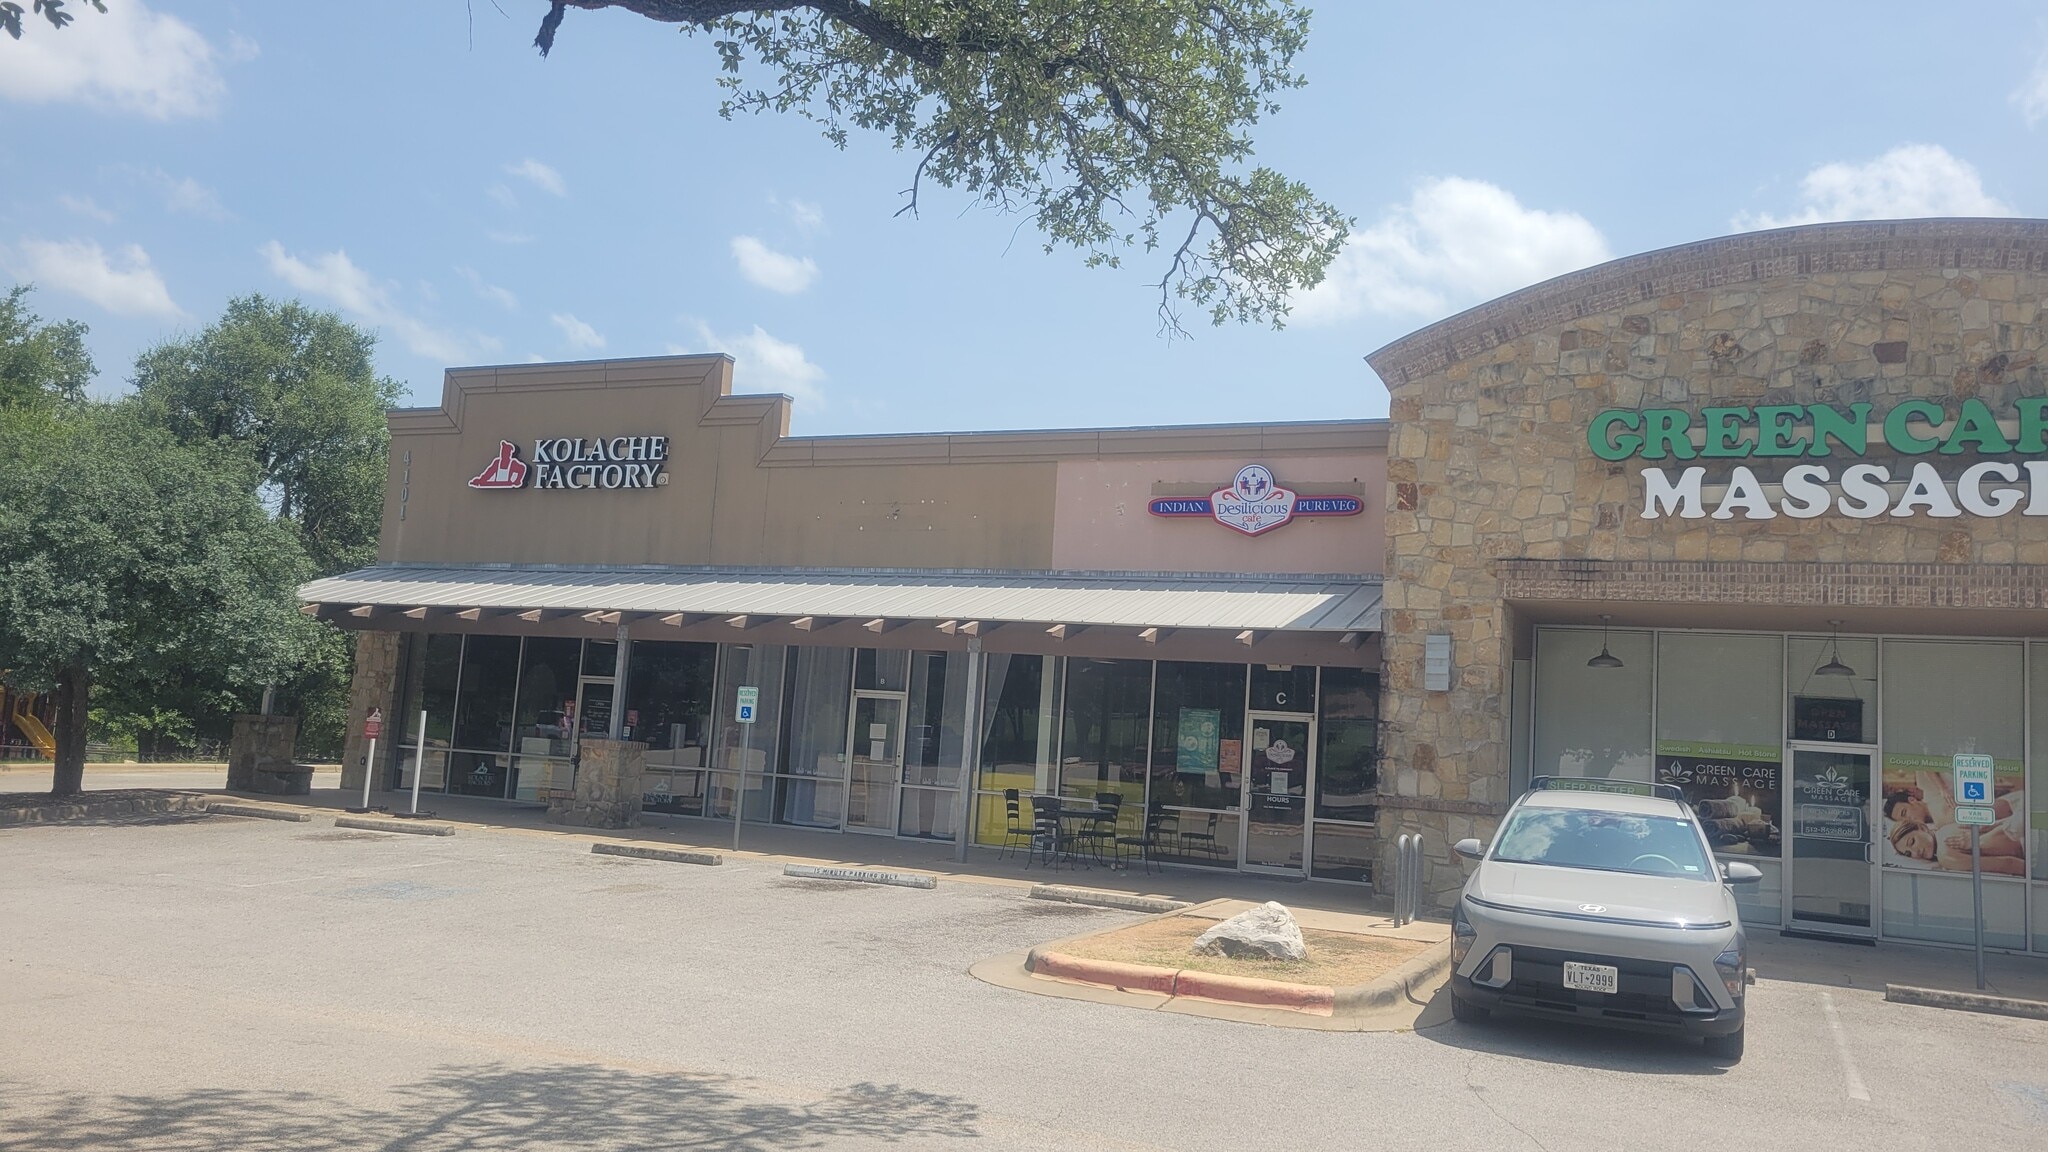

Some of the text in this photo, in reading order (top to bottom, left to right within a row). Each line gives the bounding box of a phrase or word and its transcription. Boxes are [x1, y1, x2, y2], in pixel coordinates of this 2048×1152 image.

[1587, 404, 1873, 461] GREEN
[532, 436, 665, 463] KOLACHE
[533, 463, 660, 489] FACTORY
[401, 449, 411, 521] 4101
[1159, 501, 1204, 513] INDIAN
[1217, 502, 1288, 515] Desilicious
[1299, 499, 1356, 511] PURE VEG
[1276, 692, 1287, 705] C
[1660, 744, 1691, 753] Swedish
[1698, 746, 1732, 755] Ashiatsu
[1754, 750, 1777, 758] Stone
[1889, 757, 2020, 771] Couple Massag issue
[1957, 759, 1990, 768] RESERVED
[1695, 764, 1776, 779] GREEN CARE
[1960, 770, 1988, 779] PARKING
[1696, 776, 1775, 790] MASSAGE
[1803, 786, 1861, 798] GREEN CARE
[1267, 796, 1290, 804] HOURS
[823, 869, 847, 877] MINUTE
[849, 871, 878, 879] PARKING
[880, 872, 899, 880] ONLY
